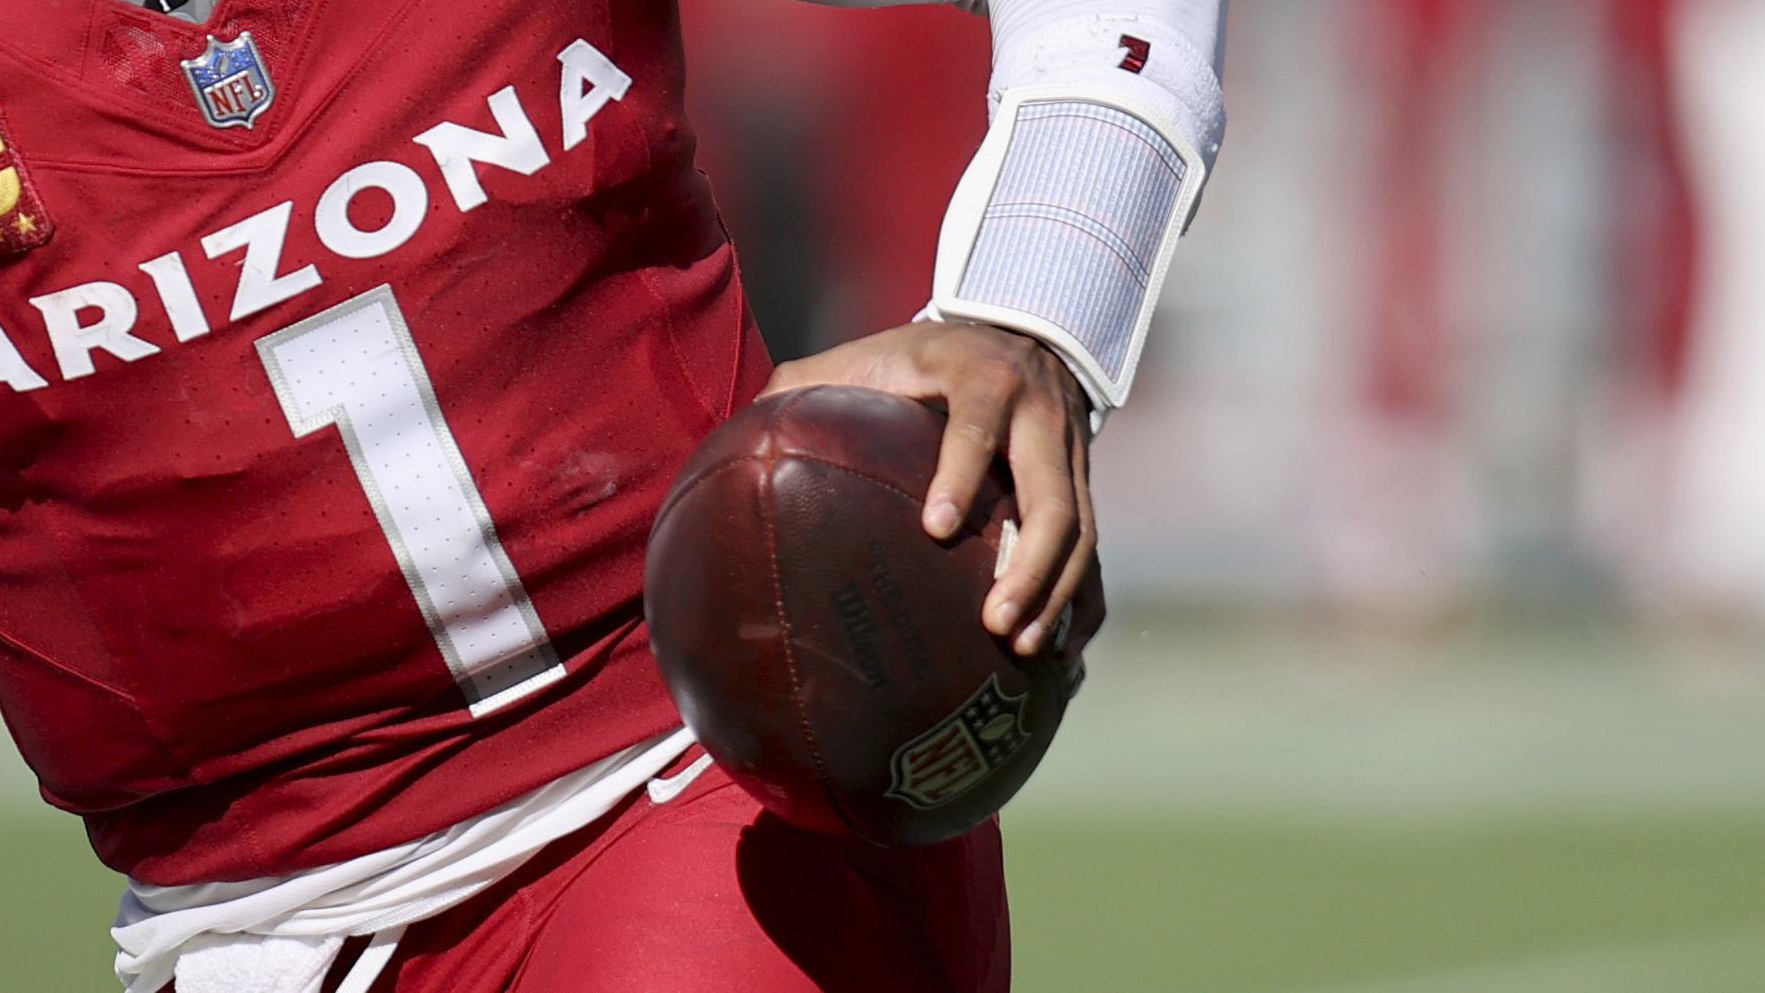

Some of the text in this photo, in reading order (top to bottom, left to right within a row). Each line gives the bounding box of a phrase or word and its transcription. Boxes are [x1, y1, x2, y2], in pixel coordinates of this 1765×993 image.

[206, 73, 265, 117] NFL
[254, 282, 567, 719] 1
[907, 723, 983, 801] NFL
